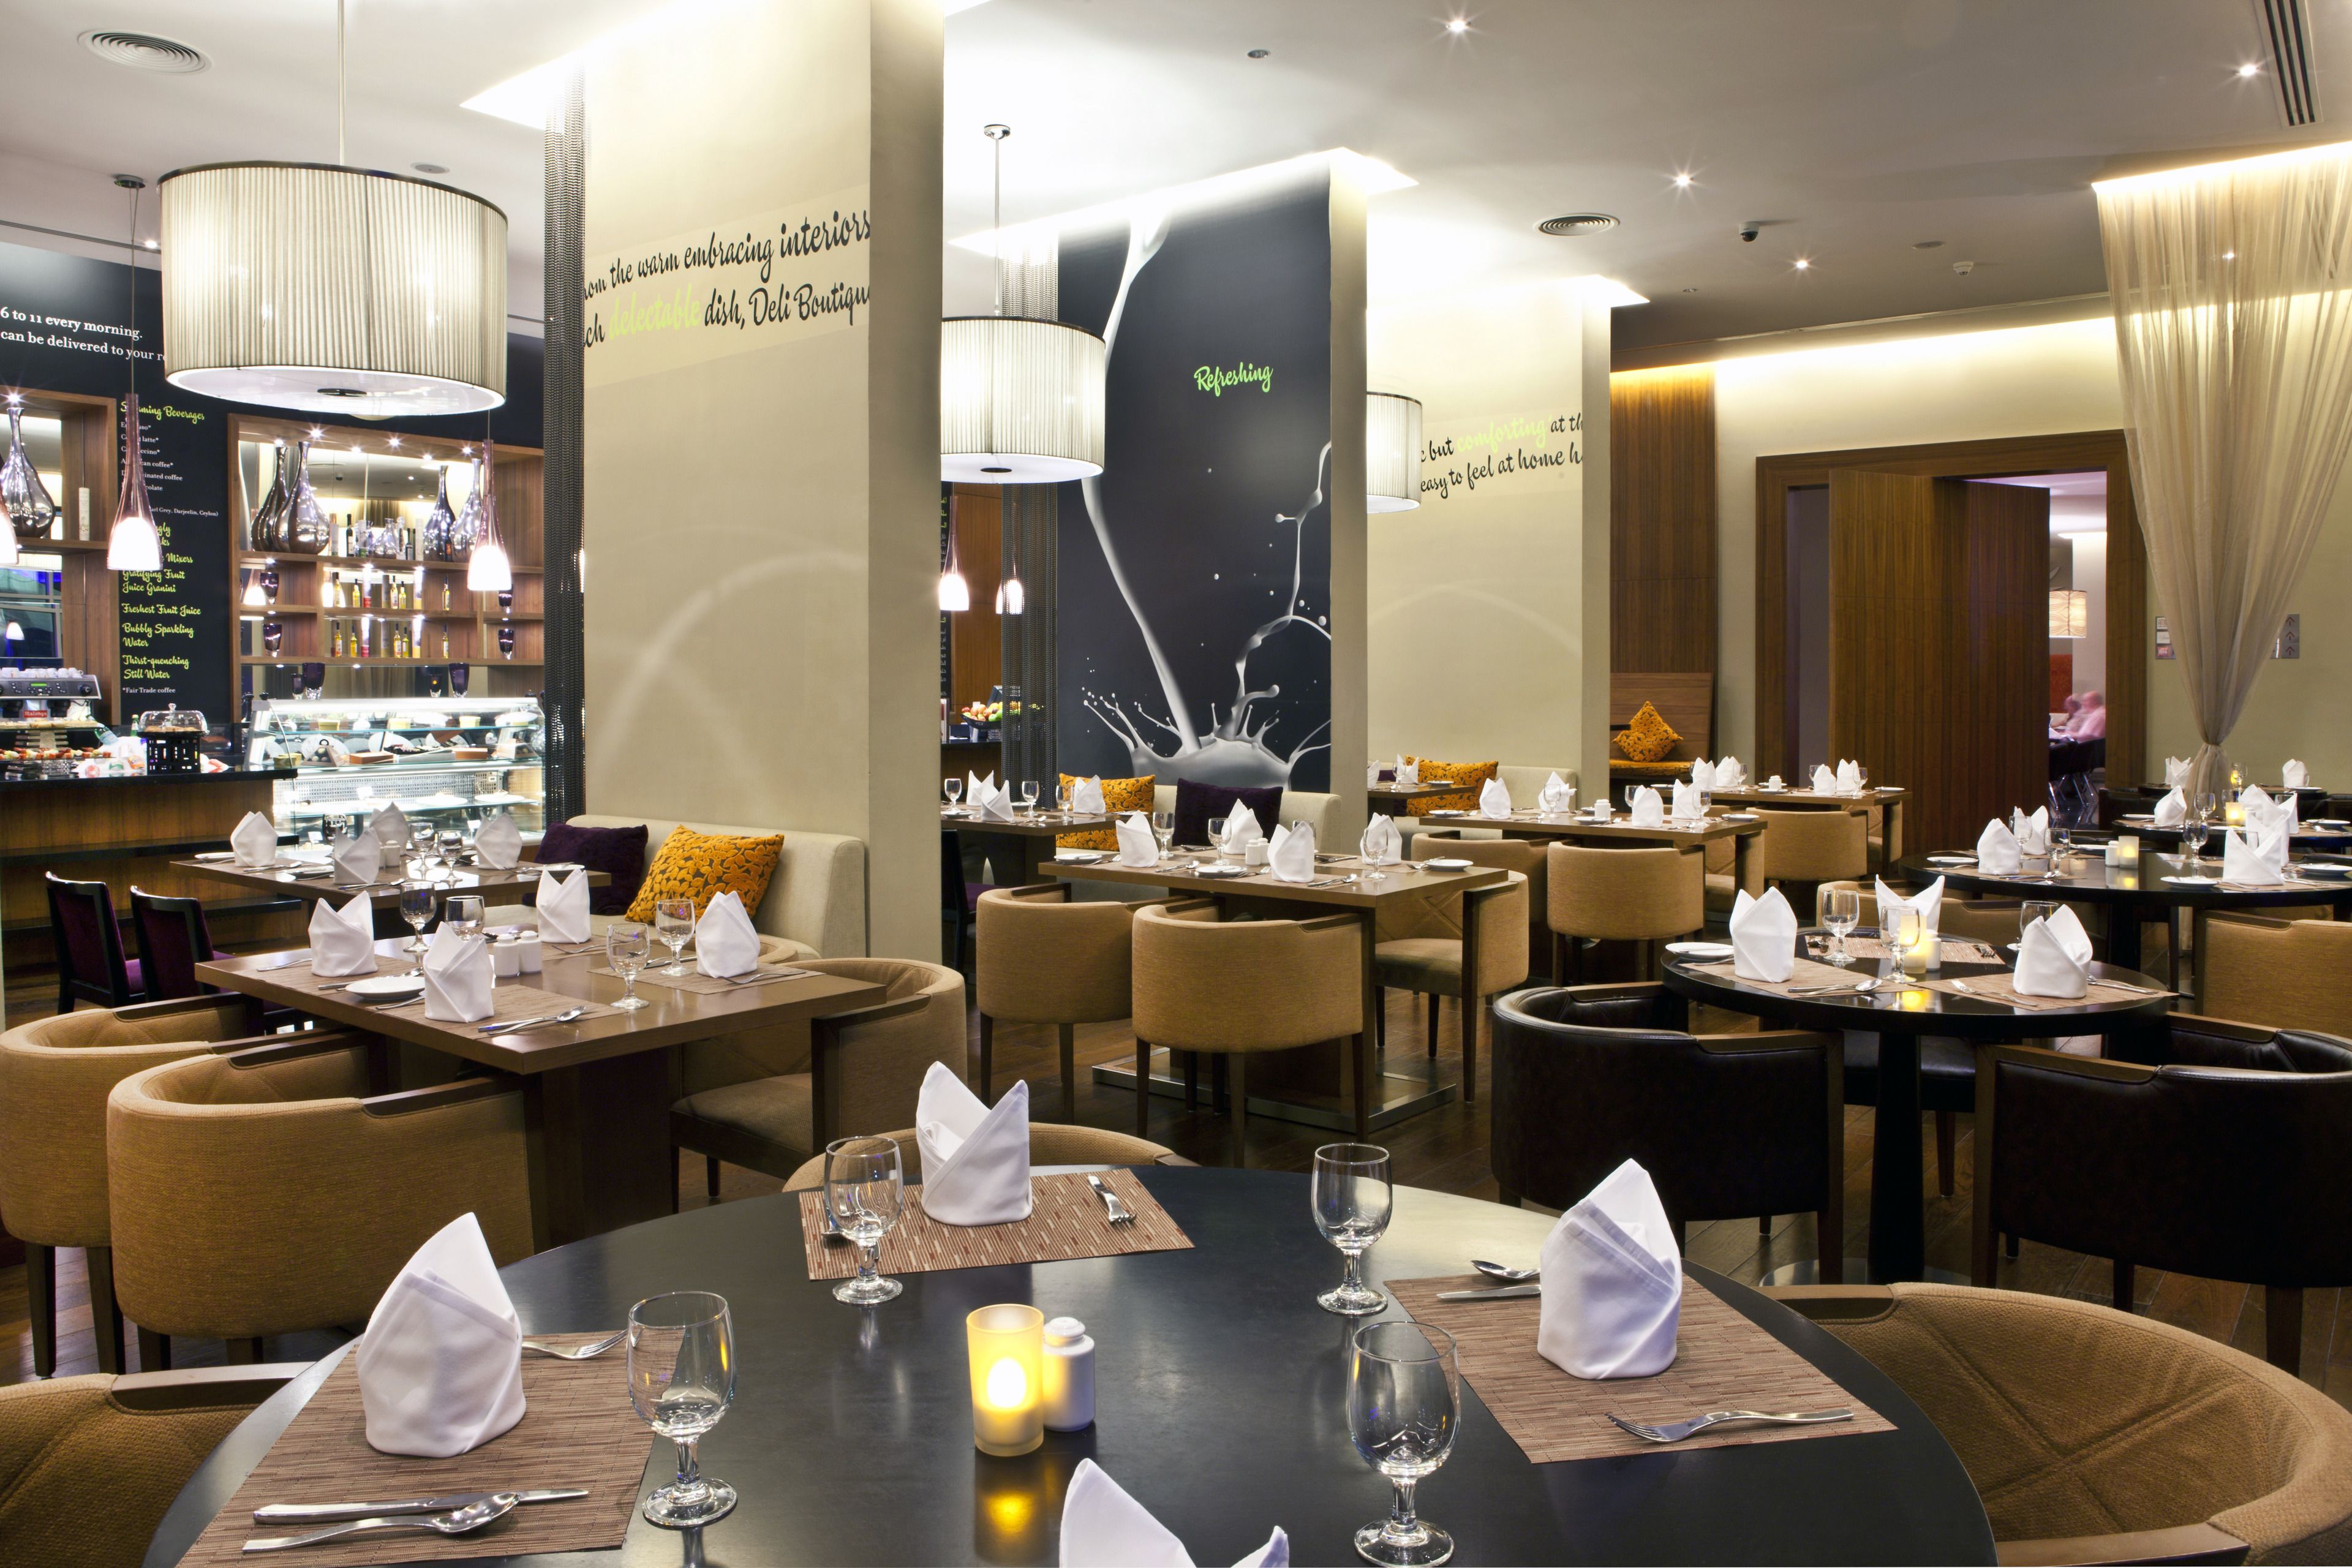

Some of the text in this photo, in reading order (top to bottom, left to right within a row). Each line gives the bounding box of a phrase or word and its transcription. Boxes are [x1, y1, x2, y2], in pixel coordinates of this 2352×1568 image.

[610, 258, 633, 288] the
[638, 252, 680, 278] warm
[684, 231, 774, 284] embracing
[780, 210, 870, 257] interiors
[608, 283, 702, 341] delectable
[704, 288, 745, 330] dish,
[748, 284, 791, 326] Deli
[0, 306, 143, 341] 6 to 11 every morning.
[0, 331, 25, 342] can
[28, 331, 44, 345] be
[47, 334, 108, 353] delivered
[111, 345, 124, 356] to
[126, 349, 154, 360] your
[1194, 361, 1273, 397] Refreshing
[164, 405, 205, 424] Beverages
[1429, 437, 1454, 461] but
[1550, 415, 1566, 433] at
[1421, 477, 1448, 499] easy
[1449, 468, 1463, 486] to
[1468, 454, 1494, 490] feel
[1498, 453, 1515, 473] at
[1518, 448, 1565, 470] home
[166, 553, 193, 564] Mixers
[123, 569, 186, 582] Gratifying Fruit
[123, 581, 176, 596] Juice Granini
[121, 603, 201, 617] Freshest Fruit Juice
[122, 622, 194, 638] Bubbly Sparkling
[123, 637, 149, 647] Water
[122, 655, 189, 669] Thirst-quenching
[124, 669, 170, 679] Still Water
